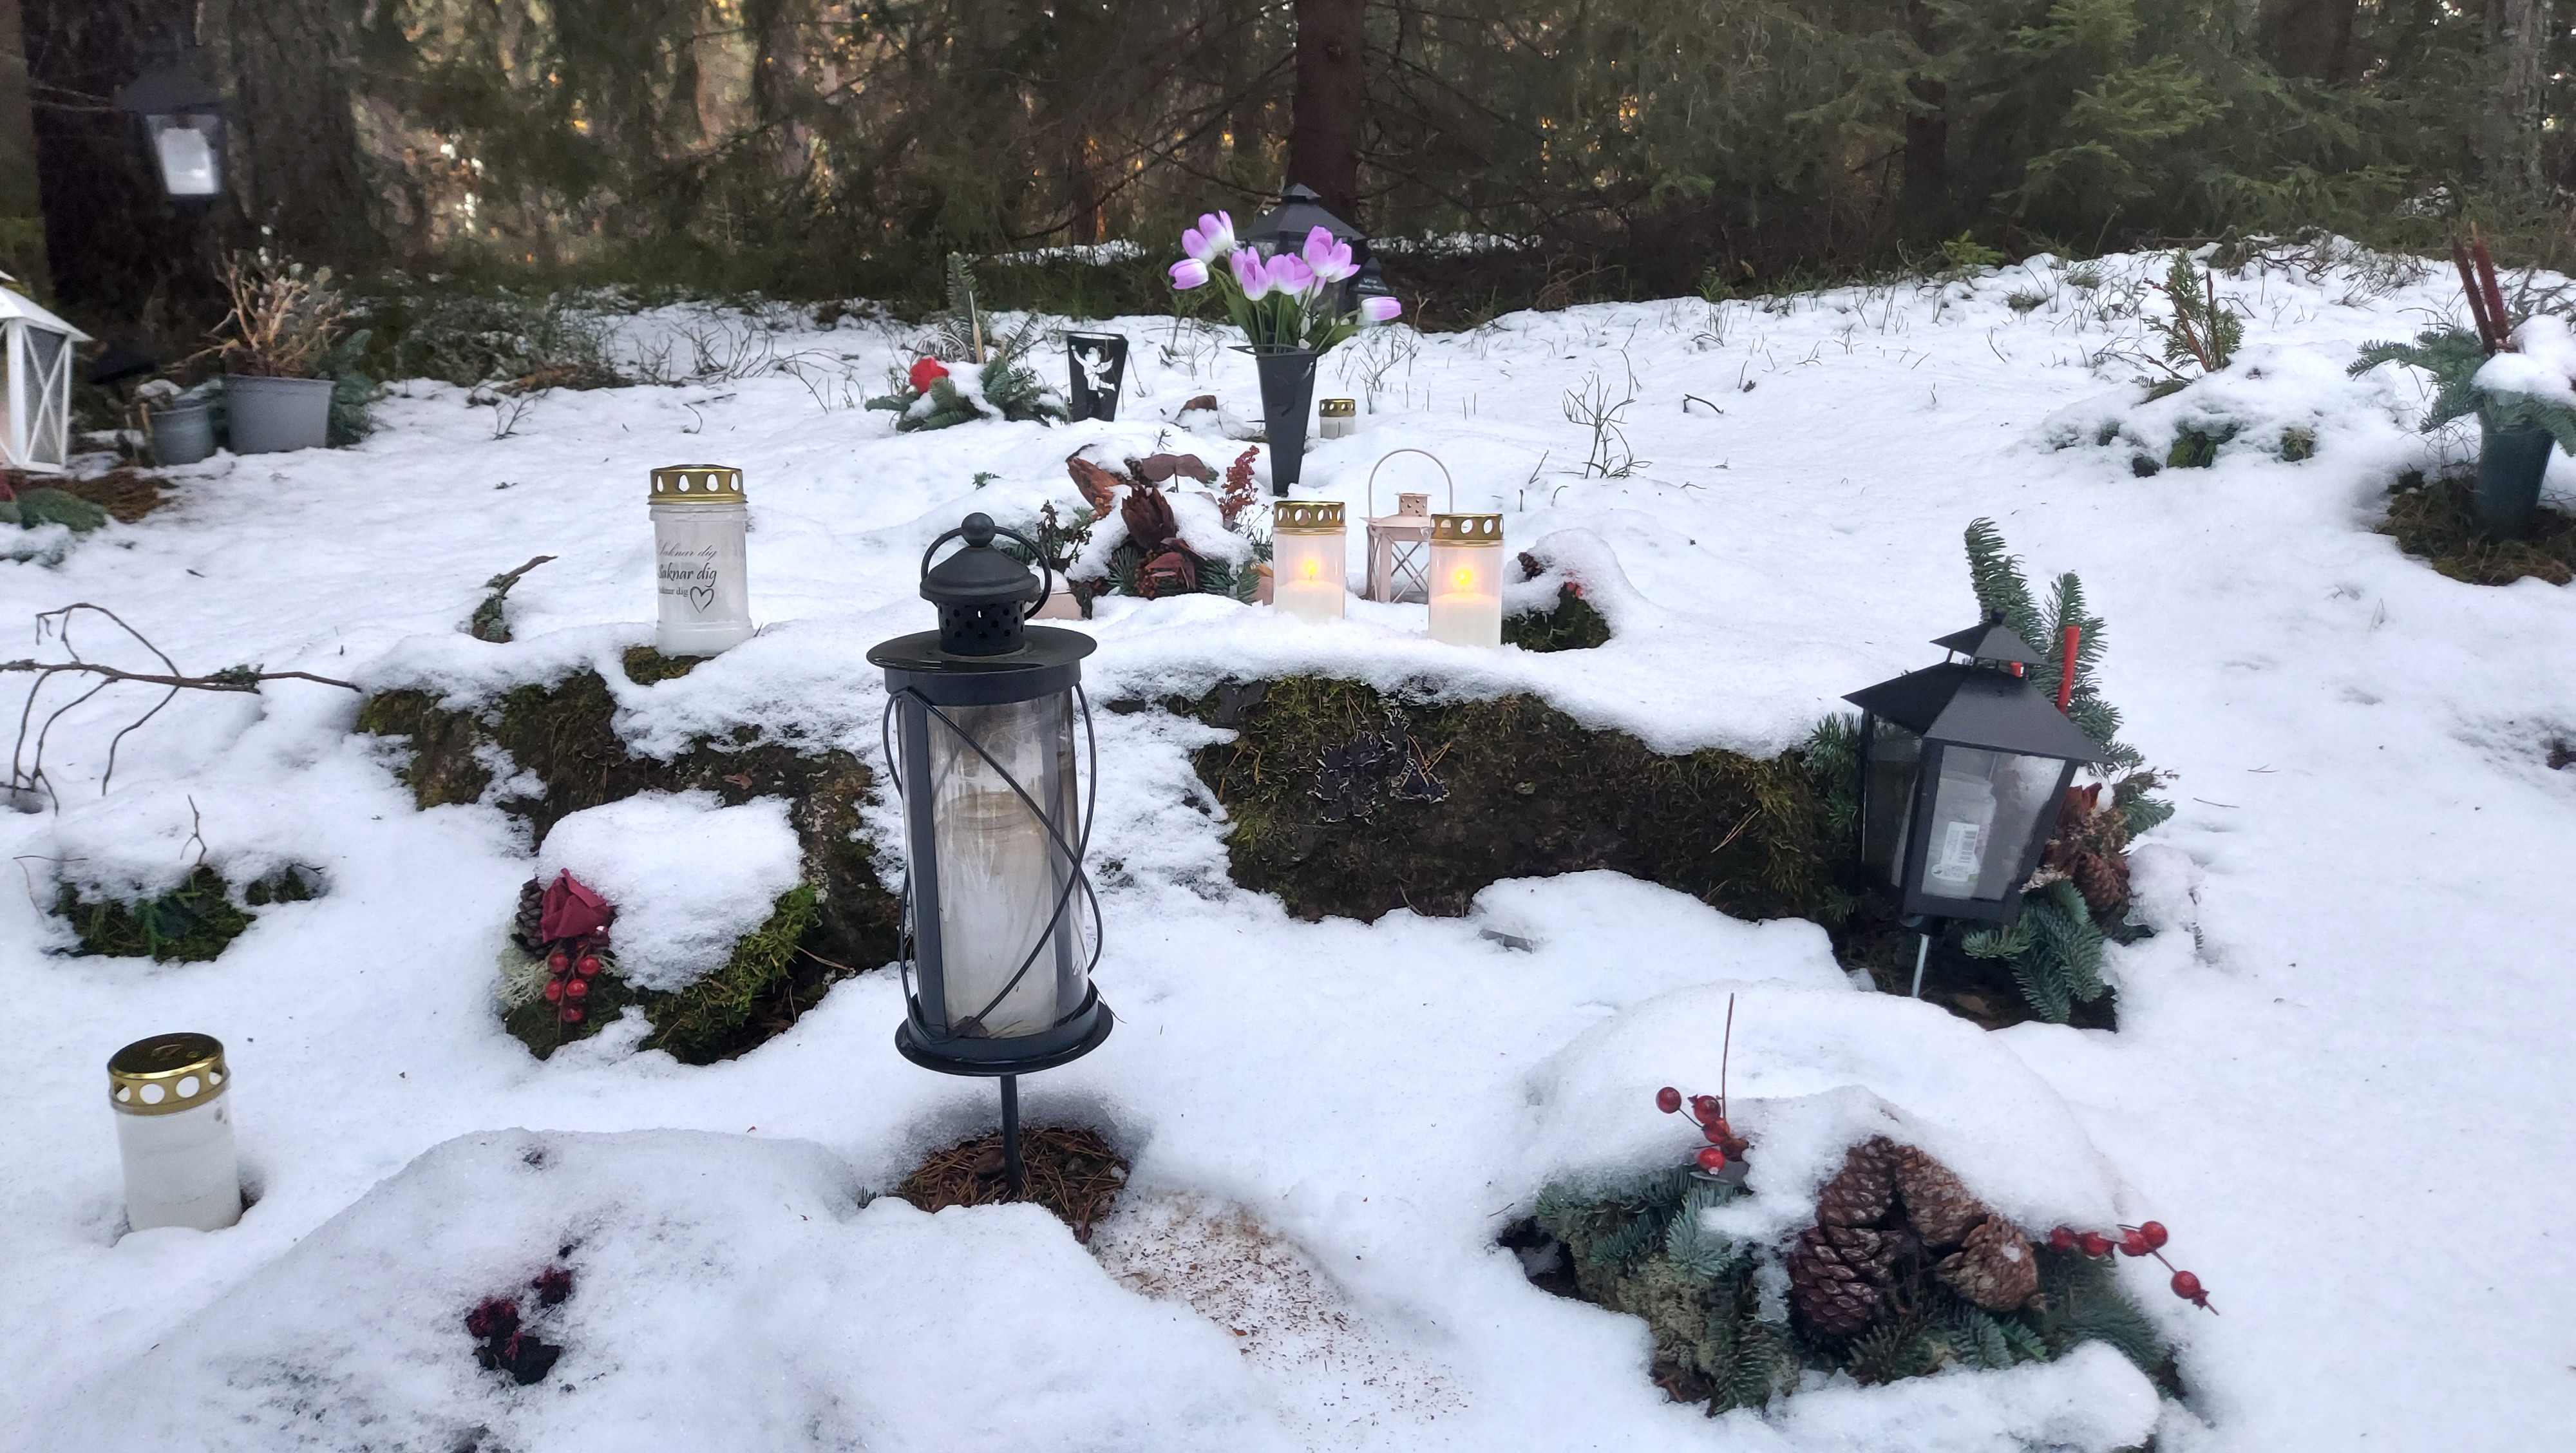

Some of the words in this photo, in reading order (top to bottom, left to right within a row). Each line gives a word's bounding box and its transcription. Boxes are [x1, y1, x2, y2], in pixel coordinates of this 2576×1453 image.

[697, 544, 717, 562] dig
[658, 562, 694, 581] Saknar
[696, 562, 717, 587] dig
[676, 587, 688, 597] dig
